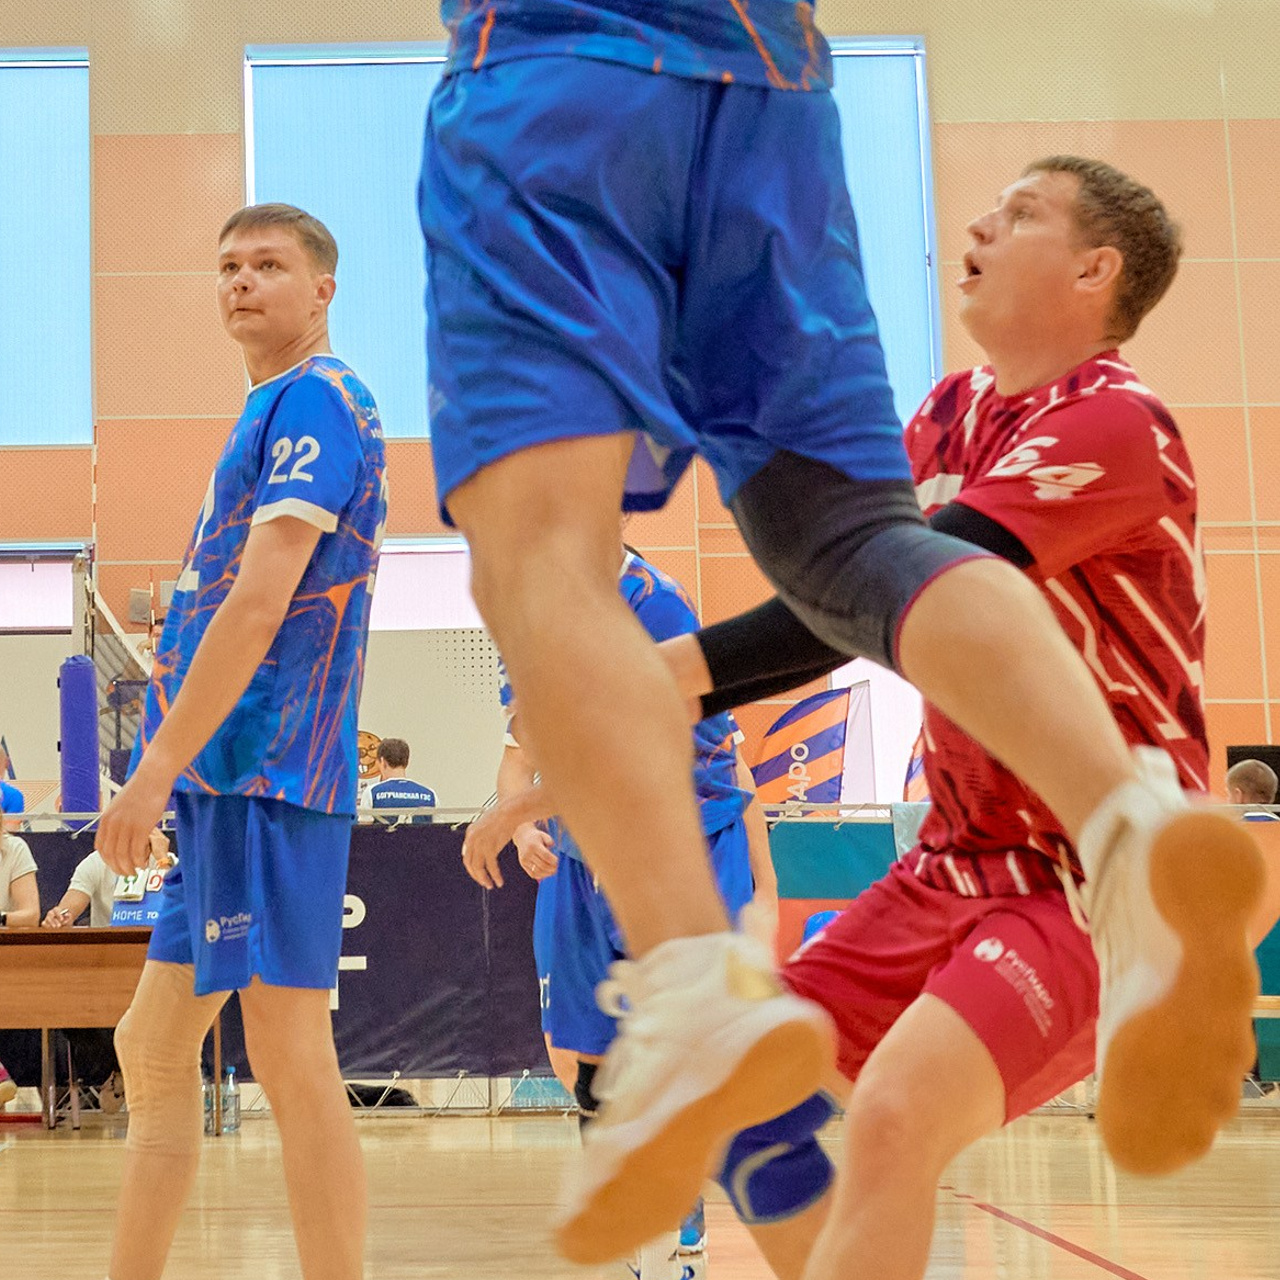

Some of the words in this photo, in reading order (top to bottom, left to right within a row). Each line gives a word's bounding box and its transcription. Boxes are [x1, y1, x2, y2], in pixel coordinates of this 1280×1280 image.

[268, 435, 320, 484] 22
[112, 910, 144, 921] HOME
[146, 911, 159, 920] TO
